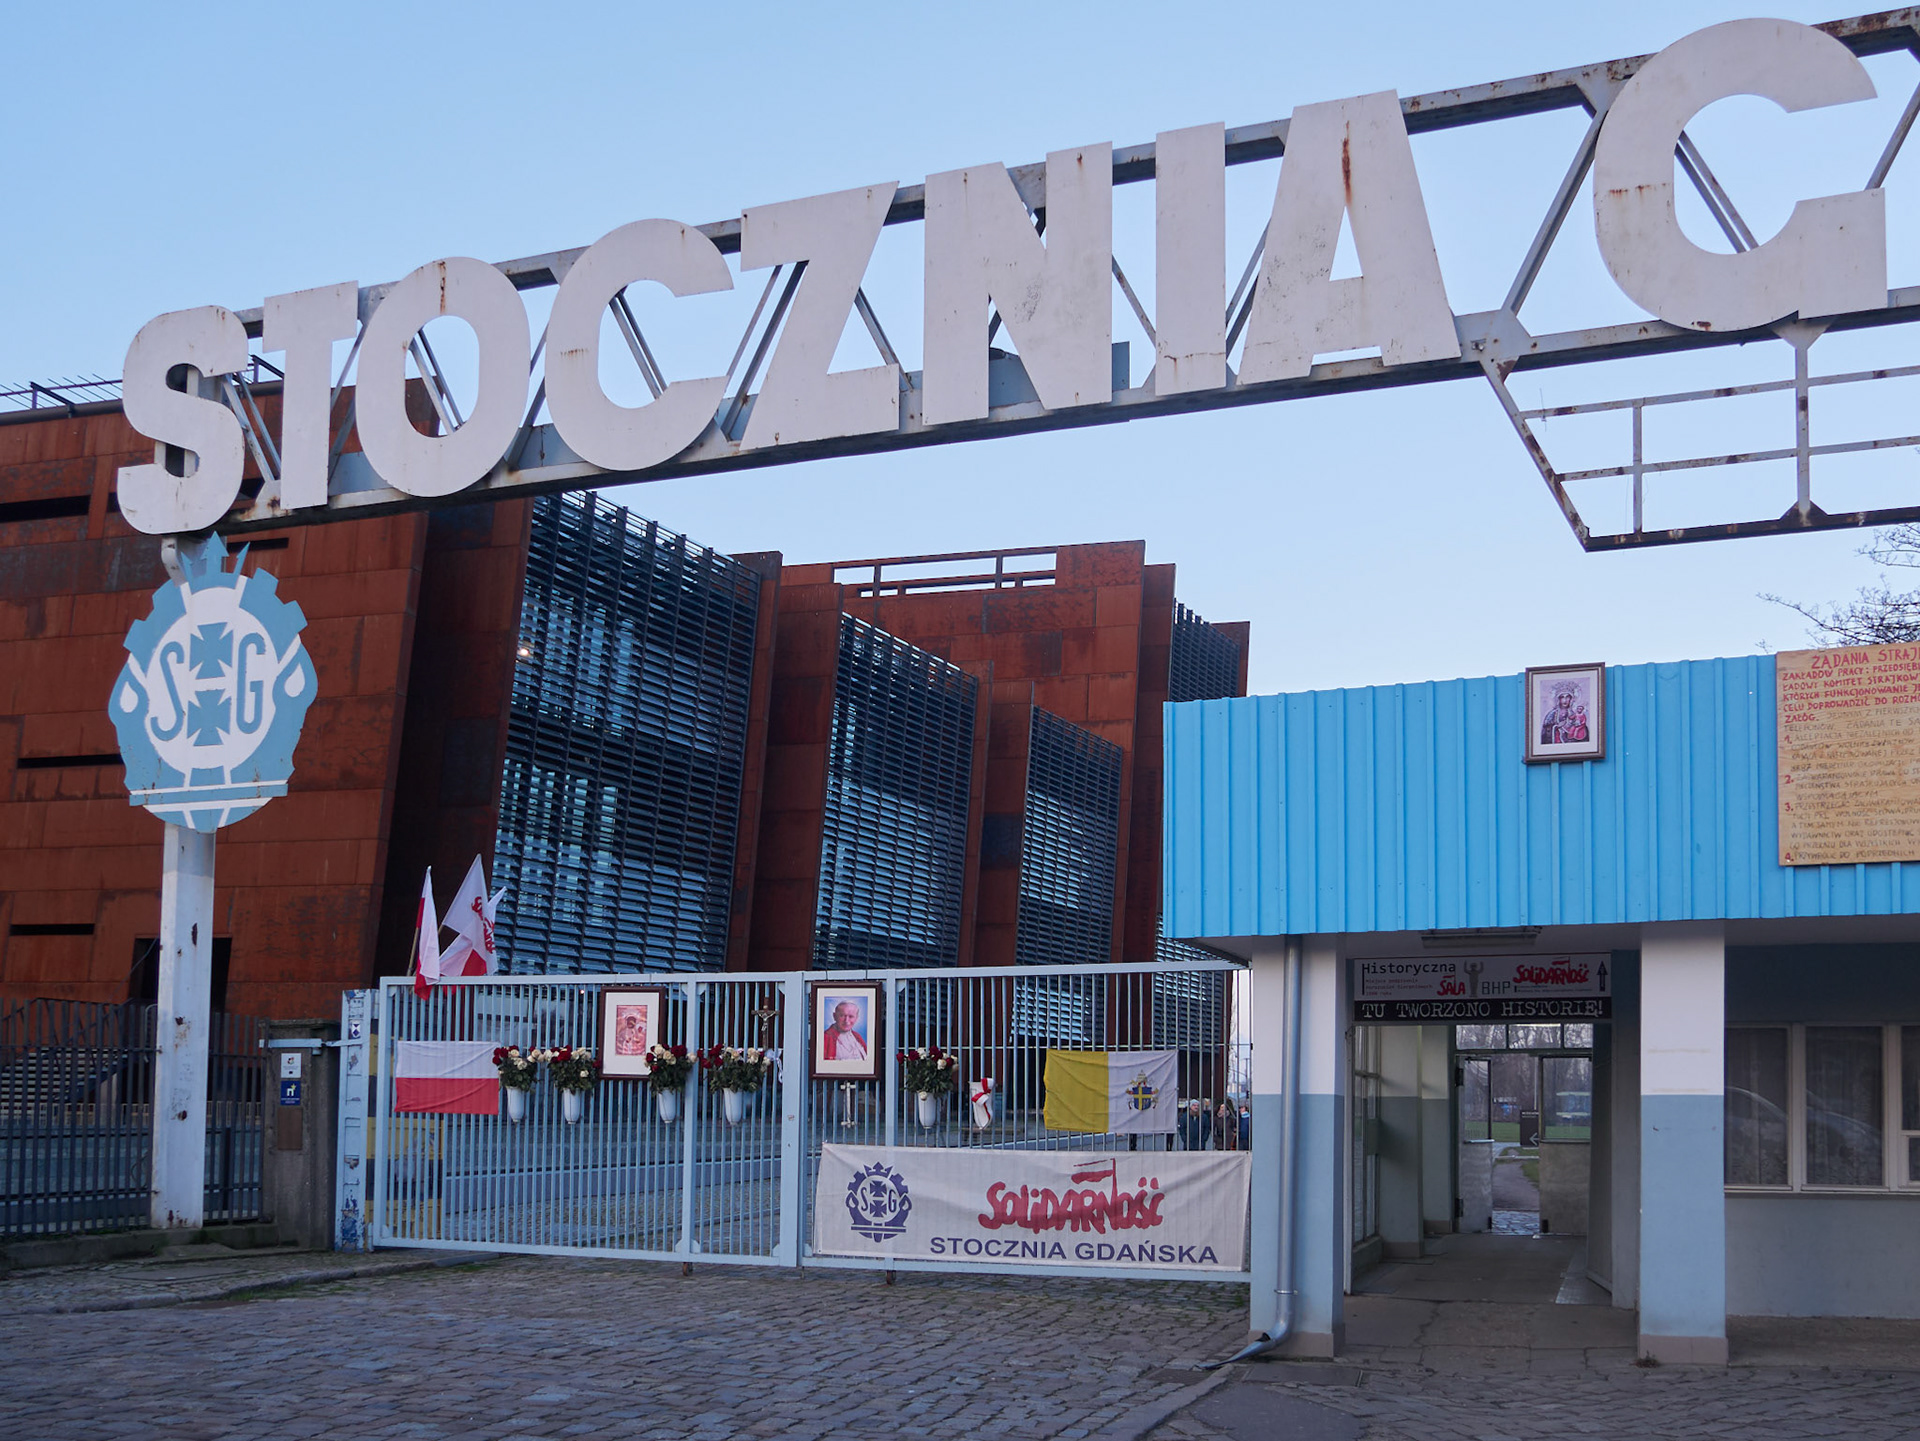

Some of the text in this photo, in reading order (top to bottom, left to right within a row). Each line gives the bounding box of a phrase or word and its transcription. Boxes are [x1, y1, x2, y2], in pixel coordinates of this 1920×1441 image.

[117, 89, 1461, 534] STOCZNIA
[151, 632, 267, 742] S G
[1824, 677, 1862, 688] KOMITET
[1824, 684, 1908, 698] FUNKCJONOWANIE
[1875, 696, 1888, 705] DO
[1362, 962, 1456, 976] Historyczna
[1436, 979, 1466, 996] SALA
[1482, 981, 1511, 995] BHP
[1361, 1003, 1386, 1018] TU
[1396, 1001, 1491, 1019] TWORZONO
[930, 1235, 1219, 1265] STOCZNIA GDAŃSKA
